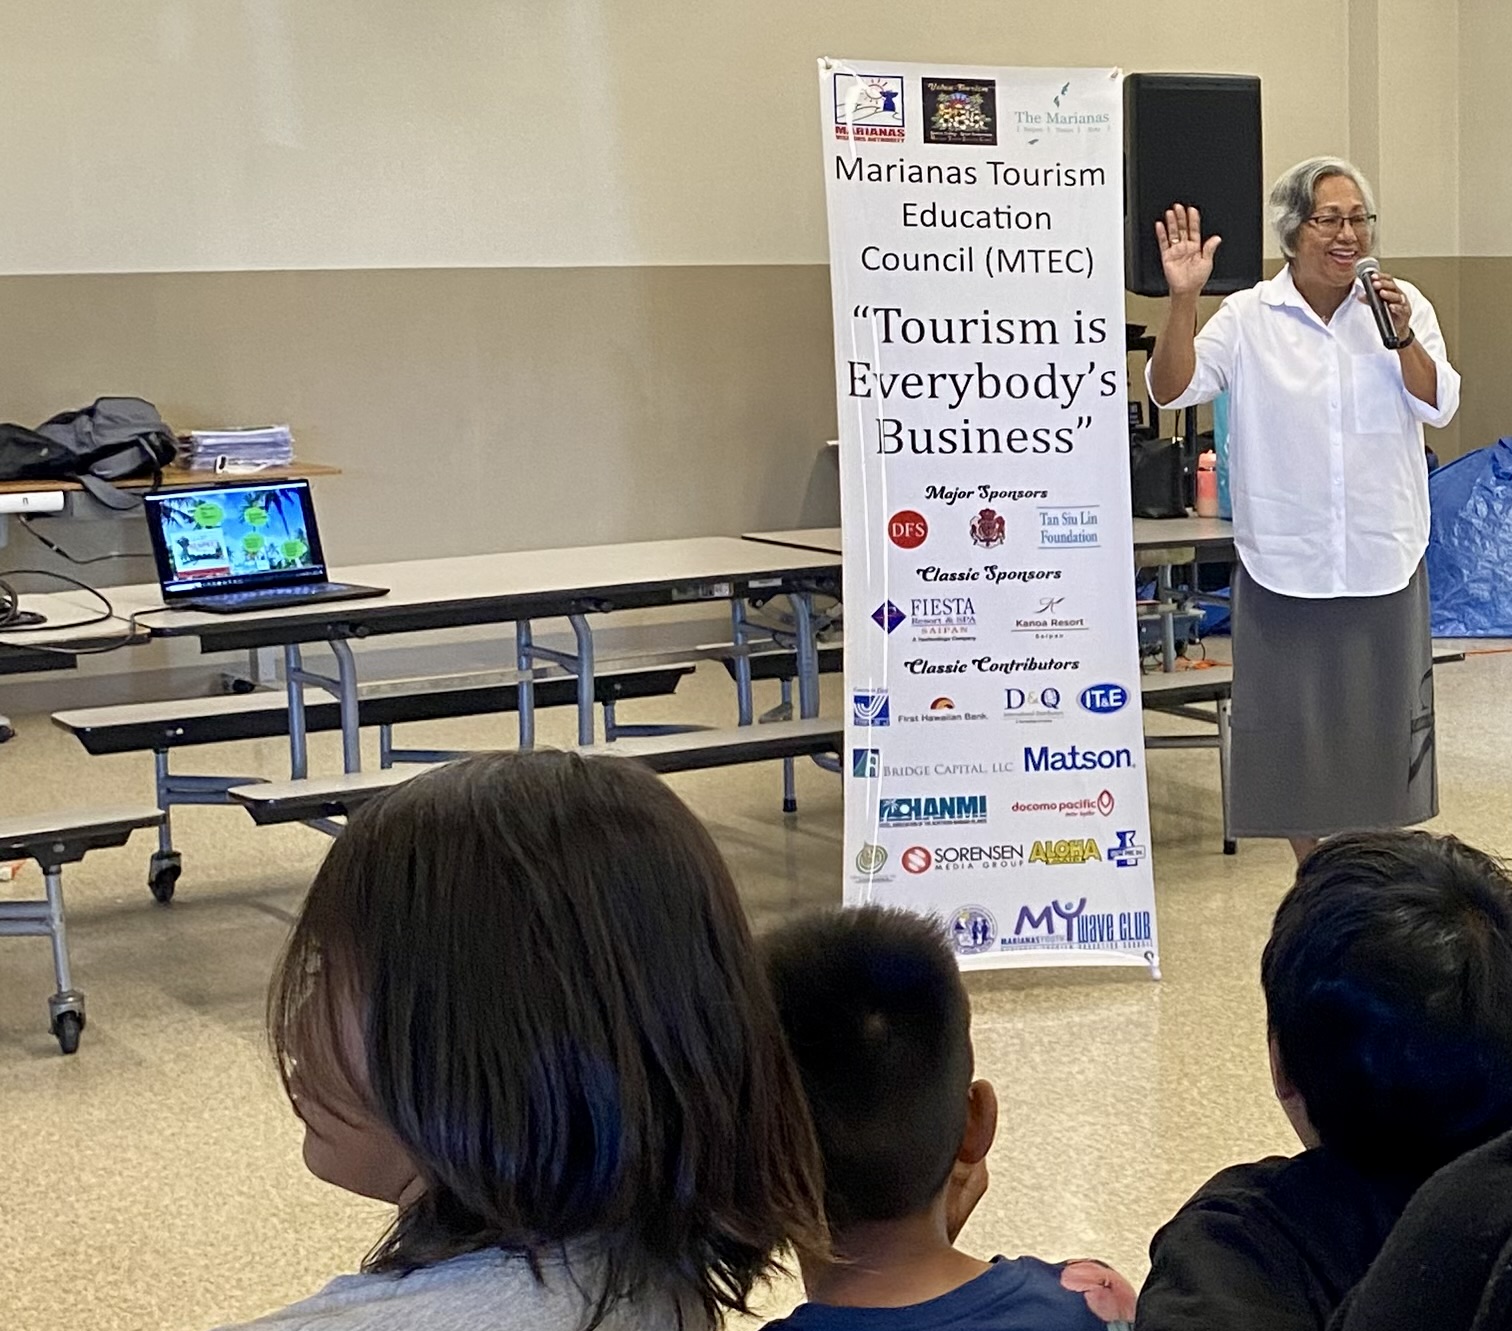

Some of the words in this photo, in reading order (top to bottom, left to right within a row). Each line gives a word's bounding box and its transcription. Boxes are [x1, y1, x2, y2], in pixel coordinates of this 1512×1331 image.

[1015, 111, 1042, 124] The
[1046, 111, 1110, 125] Marianas
[835, 126, 905, 137] MRIANAS
[836, 155, 977, 185] Marianas
[987, 161, 1106, 187] Tourism
[903, 202, 1052, 230] Education
[861, 246, 974, 273] Council
[985, 247, 1094, 278] (MTEC)
[1074, 310, 1107, 344] is
[848, 360, 1117, 409] Everybody’s
[925, 486, 974, 505] Major
[978, 485, 1048, 502] Sponsors
[1040, 512, 1060, 526] Tan
[1062, 511, 1078, 526] Siu
[1080, 511, 1098, 525] Lin
[892, 522, 925, 537] DFS
[1041, 528, 1098, 544] Foundation
[916, 566, 980, 582] Classic
[984, 565, 1062, 585] Sponsors
[911, 597, 976, 616] FIESTA
[921, 627, 968, 635] SAIPAN
[1016, 619, 1048, 628] Kanoa
[1051, 618, 1084, 627] Resort
[904, 658, 967, 675] Classic
[972, 656, 1080, 674] Contributors
[1086, 689, 1123, 709] IT&E
[898, 714, 919, 723] First
[921, 713, 962, 722] Hawaiian
[1024, 745, 1132, 773] Matson
[884, 766, 930, 777] BRIDGE
[992, 763, 1013, 772] LLC
[1012, 802, 1057, 812] docomo
[1059, 799, 1097, 812] pacific
[935, 845, 1024, 863] SORENSEN
[1028, 838, 1102, 864] ALOHA
[935, 862, 974, 870] MEDIA
[983, 860, 1024, 868] GROUP
